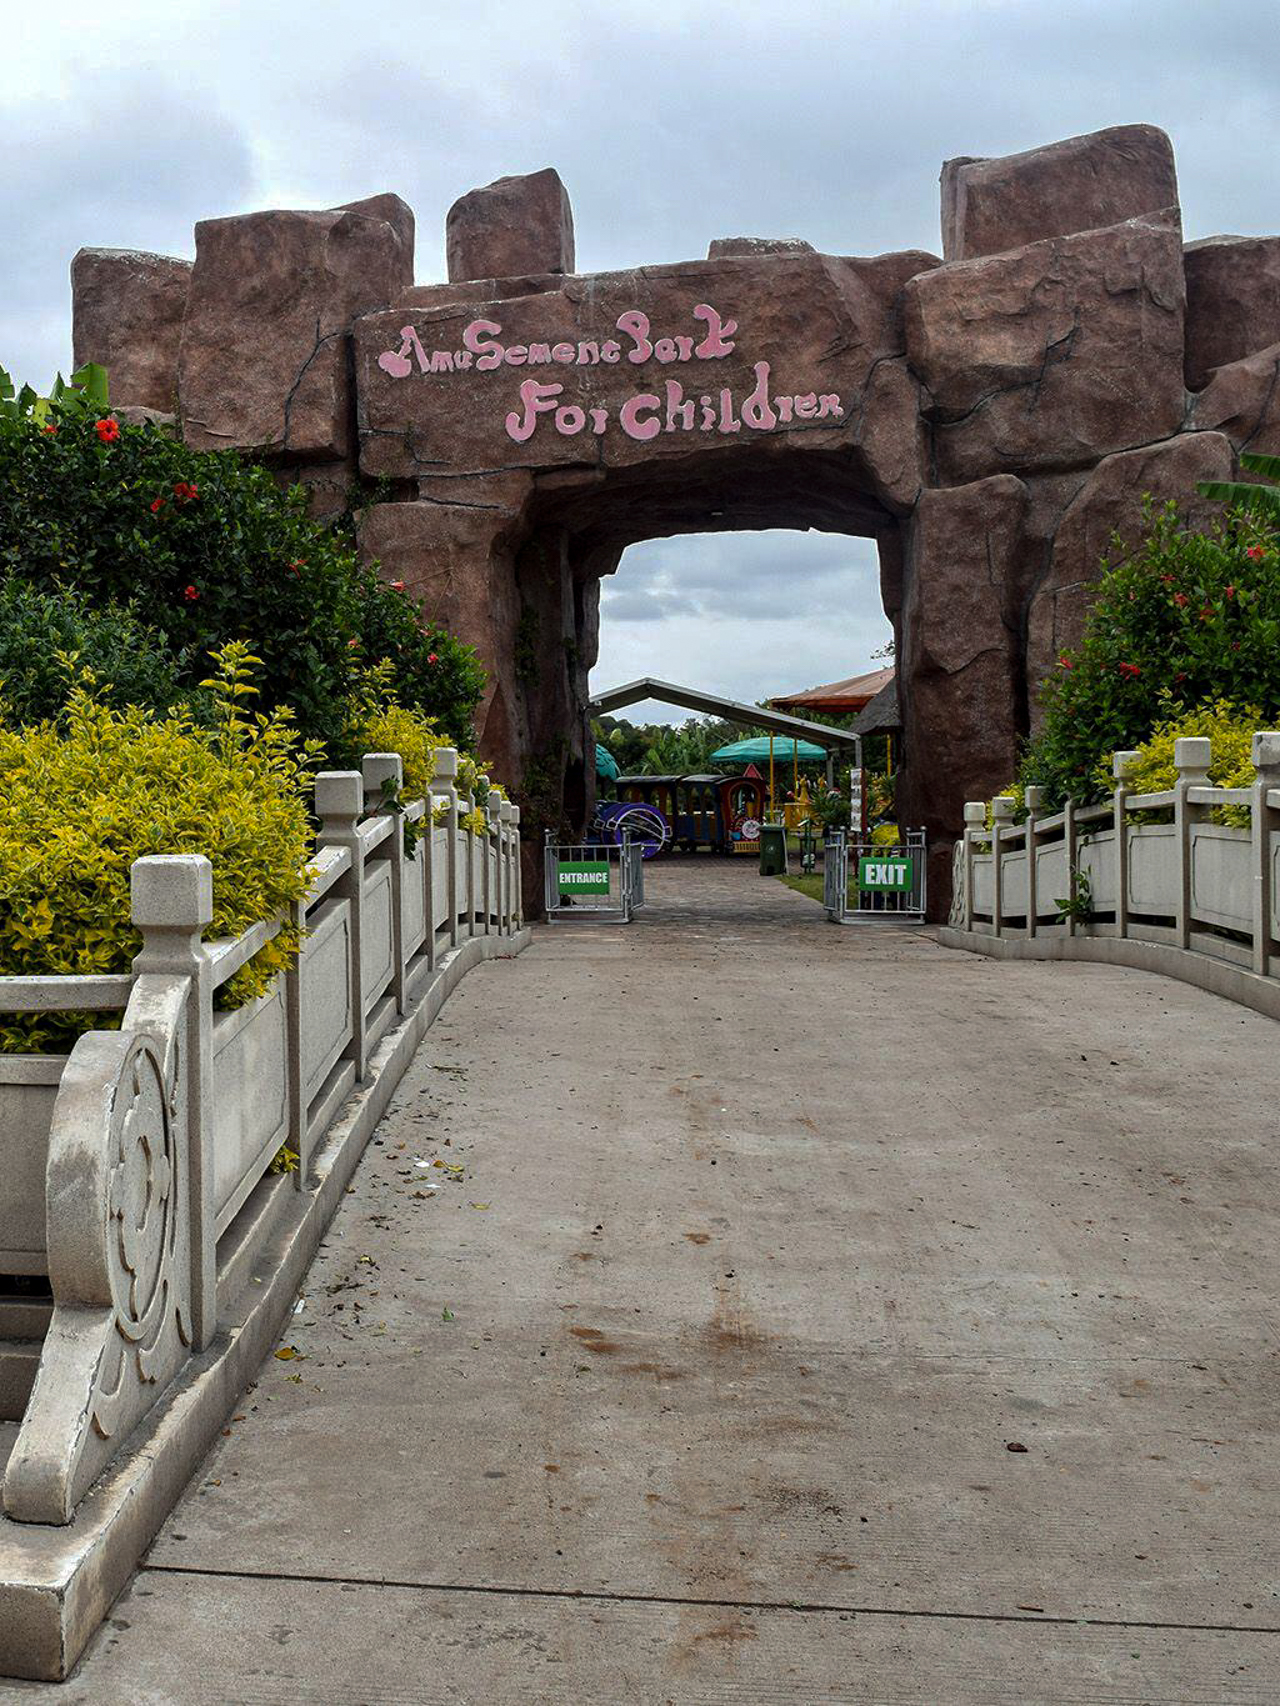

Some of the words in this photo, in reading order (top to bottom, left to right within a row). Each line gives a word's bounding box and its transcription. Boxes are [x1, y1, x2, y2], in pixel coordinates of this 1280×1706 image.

[616, 304, 738, 364] Park
[505, 379, 609, 441] For
[559, 872, 608, 883] ENTRANCE
[865, 864, 907, 885] EXIT
